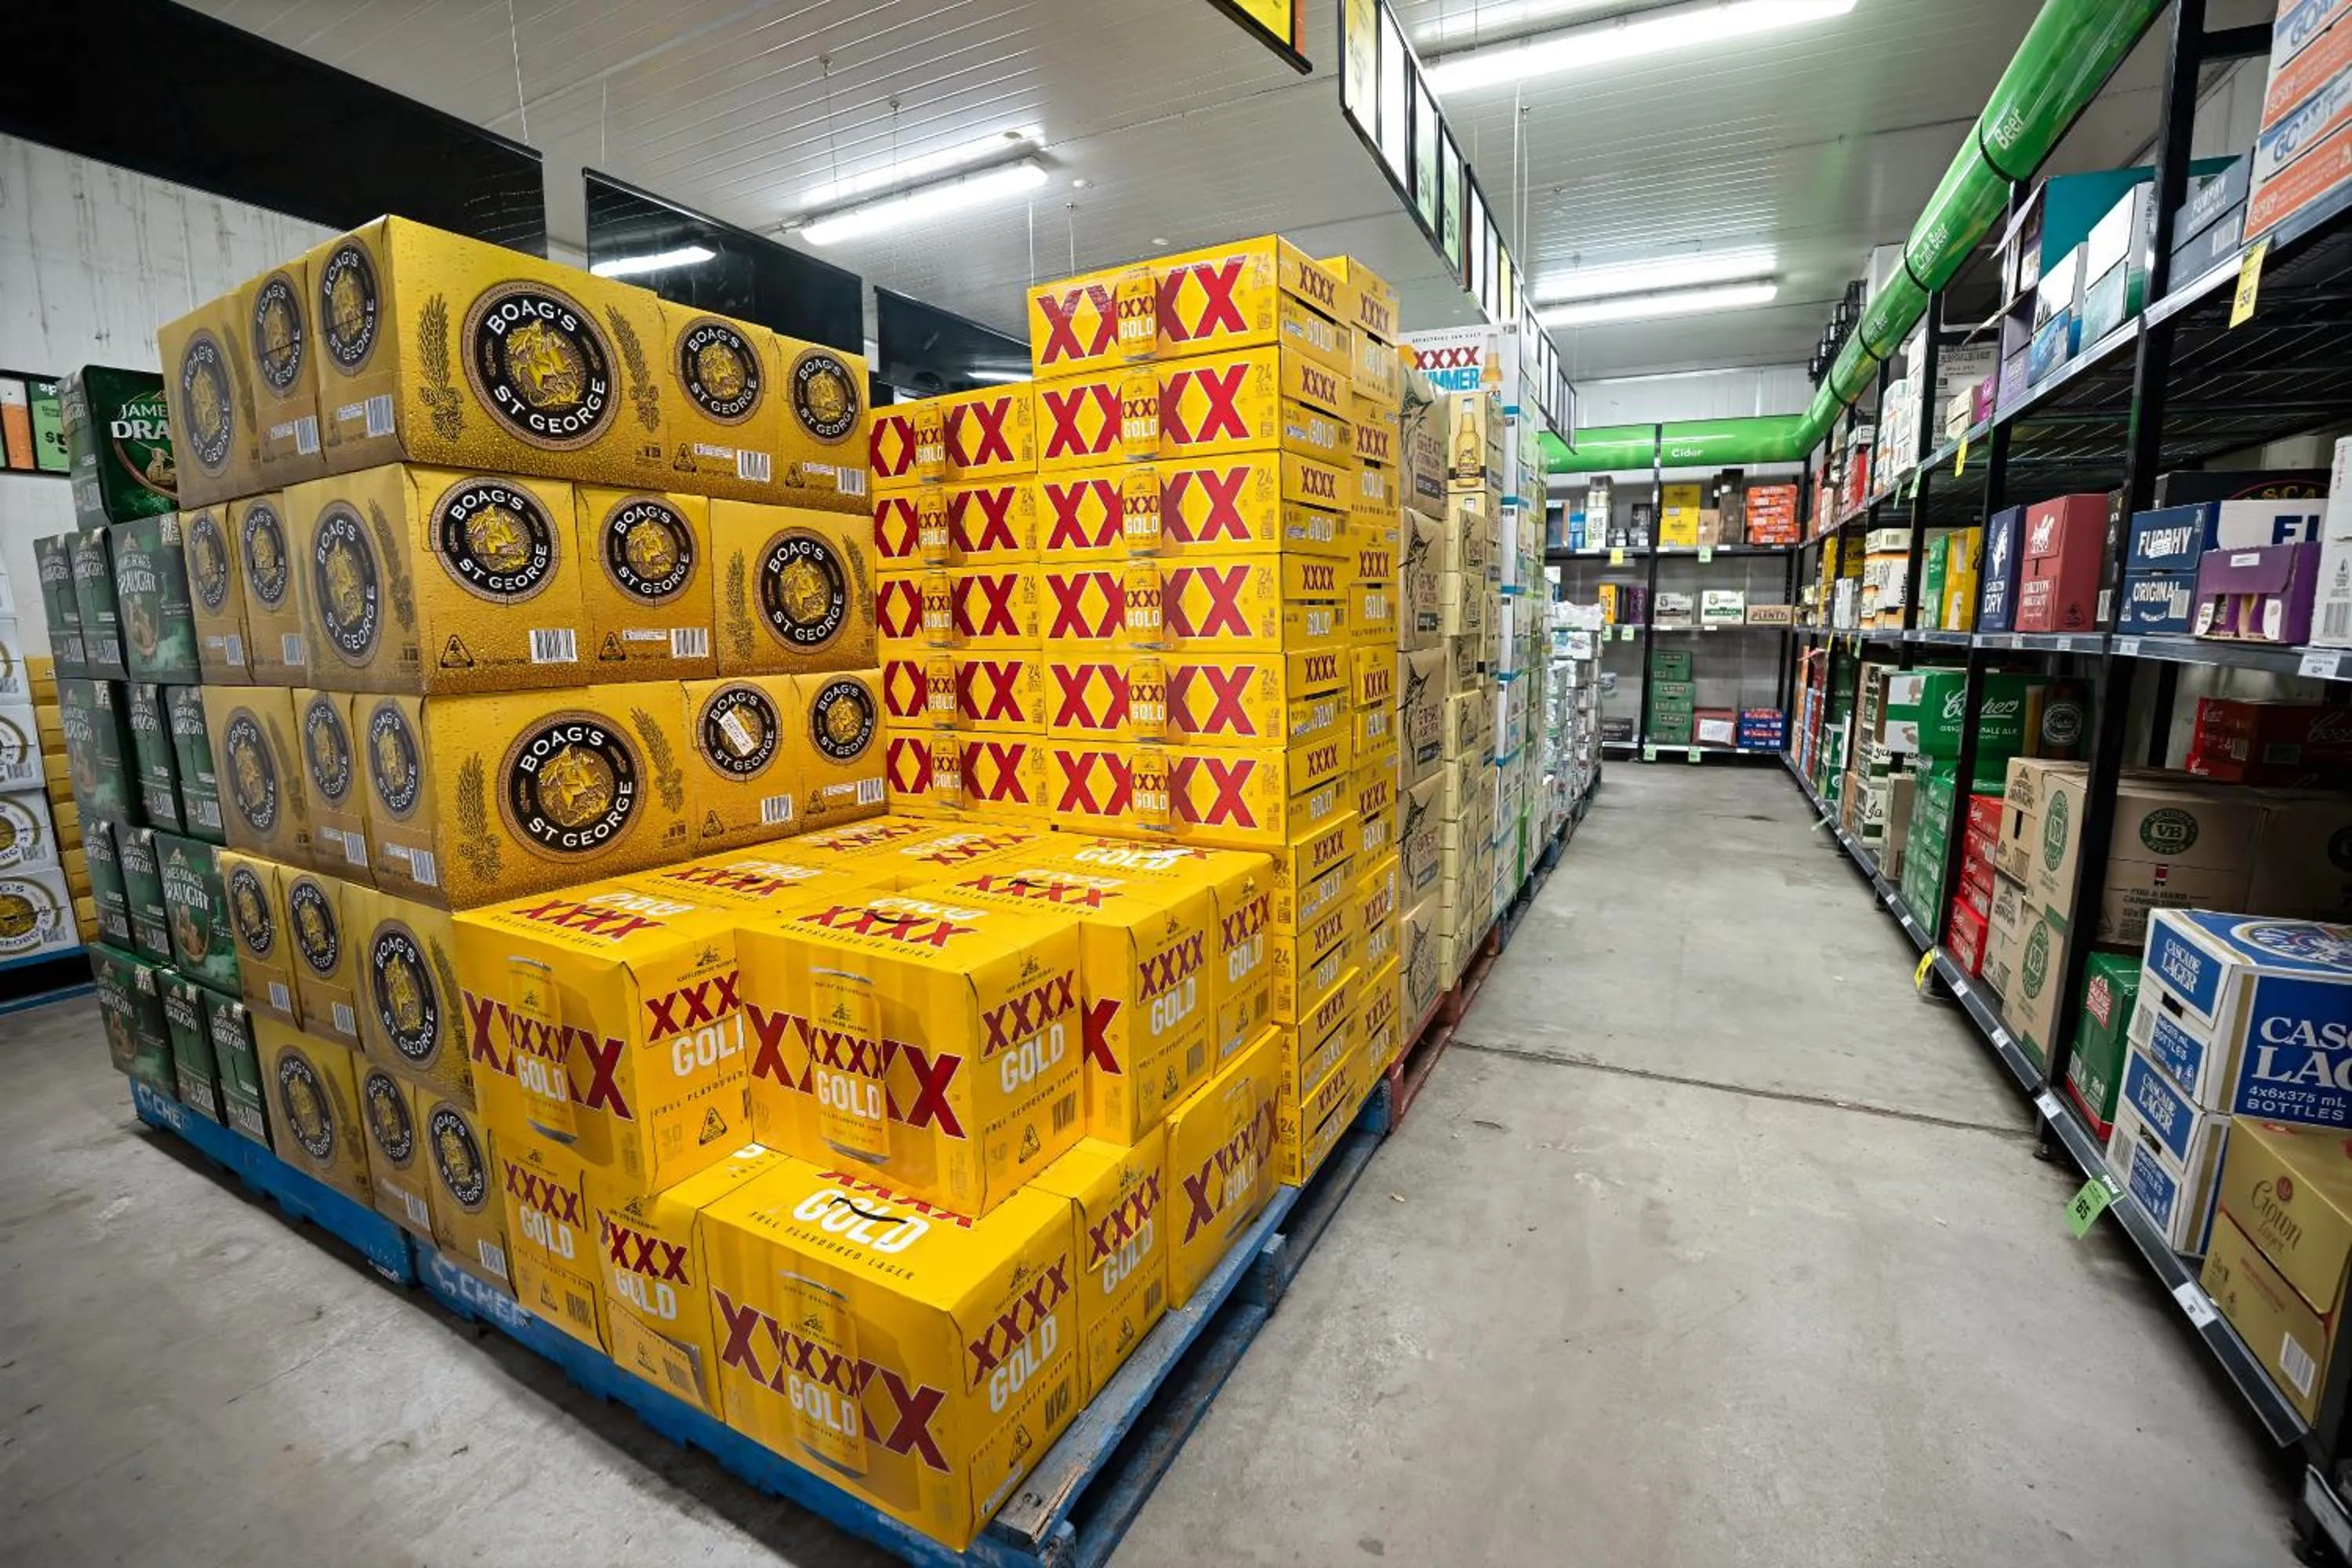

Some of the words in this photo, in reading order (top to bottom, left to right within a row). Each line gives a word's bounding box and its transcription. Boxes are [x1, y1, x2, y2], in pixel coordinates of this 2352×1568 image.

[1994, 109, 2027, 150] Beer
[1929, 223, 1949, 249] Beer
[324, 251, 358, 295] BOAG'S
[1299, 262, 1335, 308] XXXX
[342, 299, 374, 360] GEORGE
[487, 299, 577, 336] BOAG'S
[1120, 316, 1154, 339] GOLD
[688, 331, 740, 353] BOAG'S
[1412, 346, 1479, 370] XXXX
[799, 360, 842, 379] BOAG'S
[1301, 365, 1336, 405] XXXX
[122, 403, 169, 419] JAME
[494, 386, 525, 416] ST
[530, 377, 606, 434] GEORGE
[691, 381, 709, 408] ST
[711, 378, 758, 415] GEORGE
[111, 419, 170, 441] DRA
[800, 408, 815, 428] ST
[816, 403, 856, 436] GEORGE
[1123, 418, 1156, 438] GOLD
[1356, 424, 1388, 458] XXXX
[1671, 448, 1704, 459] Cider
[1301, 466, 1334, 498] XXXX
[450, 490, 524, 521] BOAG'S
[614, 506, 672, 535] BOAG'S
[1124, 515, 1159, 535] GOLD
[318, 520, 356, 564] BOAG'S
[768, 542, 826, 573] BOAG'S
[459, 558, 487, 582] ST
[488, 543, 548, 590] GEORGE
[617, 566, 640, 590] ST
[640, 551, 691, 593] GEORGE
[1303, 564, 1334, 590] XXXX
[1359, 551, 1389, 577] XXXX
[343, 585, 376, 649] GEORGE
[772, 611, 794, 637] ST
[793, 593, 844, 641] GEORGE
[1127, 608, 1160, 626] GOLD
[1984, 593, 2004, 614] DRY
[1305, 655, 1337, 683] XXXX
[709, 692, 759, 720] BOAG'S
[817, 684, 859, 712] BOAG'S
[1131, 704, 1163, 721] GOLD
[520, 727, 605, 774] BOAG'S
[714, 749, 734, 768] ST
[732, 729, 775, 771] GEORGE
[818, 735, 837, 754] ST
[835, 717, 873, 756] GEORGE
[1308, 746, 1338, 778] XXXX
[528, 817, 559, 844] ST
[562, 781, 633, 848] GEORGE
[1135, 792, 1167, 811] GOLD
[2156, 824, 2183, 838] VB
[1072, 847, 1193, 870] GOLD
[662, 866, 801, 896] XXXX
[956, 873, 1123, 909] XXXX
[512, 899, 665, 942] XXXX
[797, 905, 978, 948] XXXX
[1221, 892, 1270, 953] XXXX
[376, 938, 416, 968] BOAG'S
[1139, 929, 1203, 1003] XXXX
[1229, 933, 1263, 982] GOLD
[1274, 948, 1290, 964] 24
[2161, 951, 2198, 994] LAGER
[2165, 939, 2202, 973] CASCADE
[981, 969, 1076, 1058] XXXX
[1151, 977, 1195, 1036] GOLD
[399, 1006, 434, 1055] GEORGE
[516, 1054, 567, 1102] GOLD
[1000, 1023, 1064, 1094] GOLD
[816, 1070, 881, 1120] GOLD
[2138, 1087, 2175, 1136] LAGER
[2142, 1071, 2177, 1118] CASCADE
[2246, 1098, 2346, 1122] BOTTLES
[2247, 1086, 2318, 1104] 4x6x375
[2321, 1094, 2347, 1109] mL
[503, 1158, 581, 1228] XXXX
[1225, 1156, 1254, 1207] GOLD
[520, 1204, 574, 1260] GOLD
[793, 1188, 929, 1254] GOLD
[1089, 1167, 1160, 1268] XXXX
[2251, 1179, 2303, 1250] Crown
[596, 1207, 690, 1286] XXXX
[749, 1210, 782, 1230] FULL
[786, 1225, 863, 1261] FLAVOURED
[867, 1259, 916, 1281] LAGER
[1103, 1217, 1153, 1295] GOLD
[614, 1269, 676, 1319] GOLD
[967, 1253, 1069, 1387] XXXX
[988, 1314, 1058, 1414] GOLD
[789, 1373, 857, 1438] GOLD
